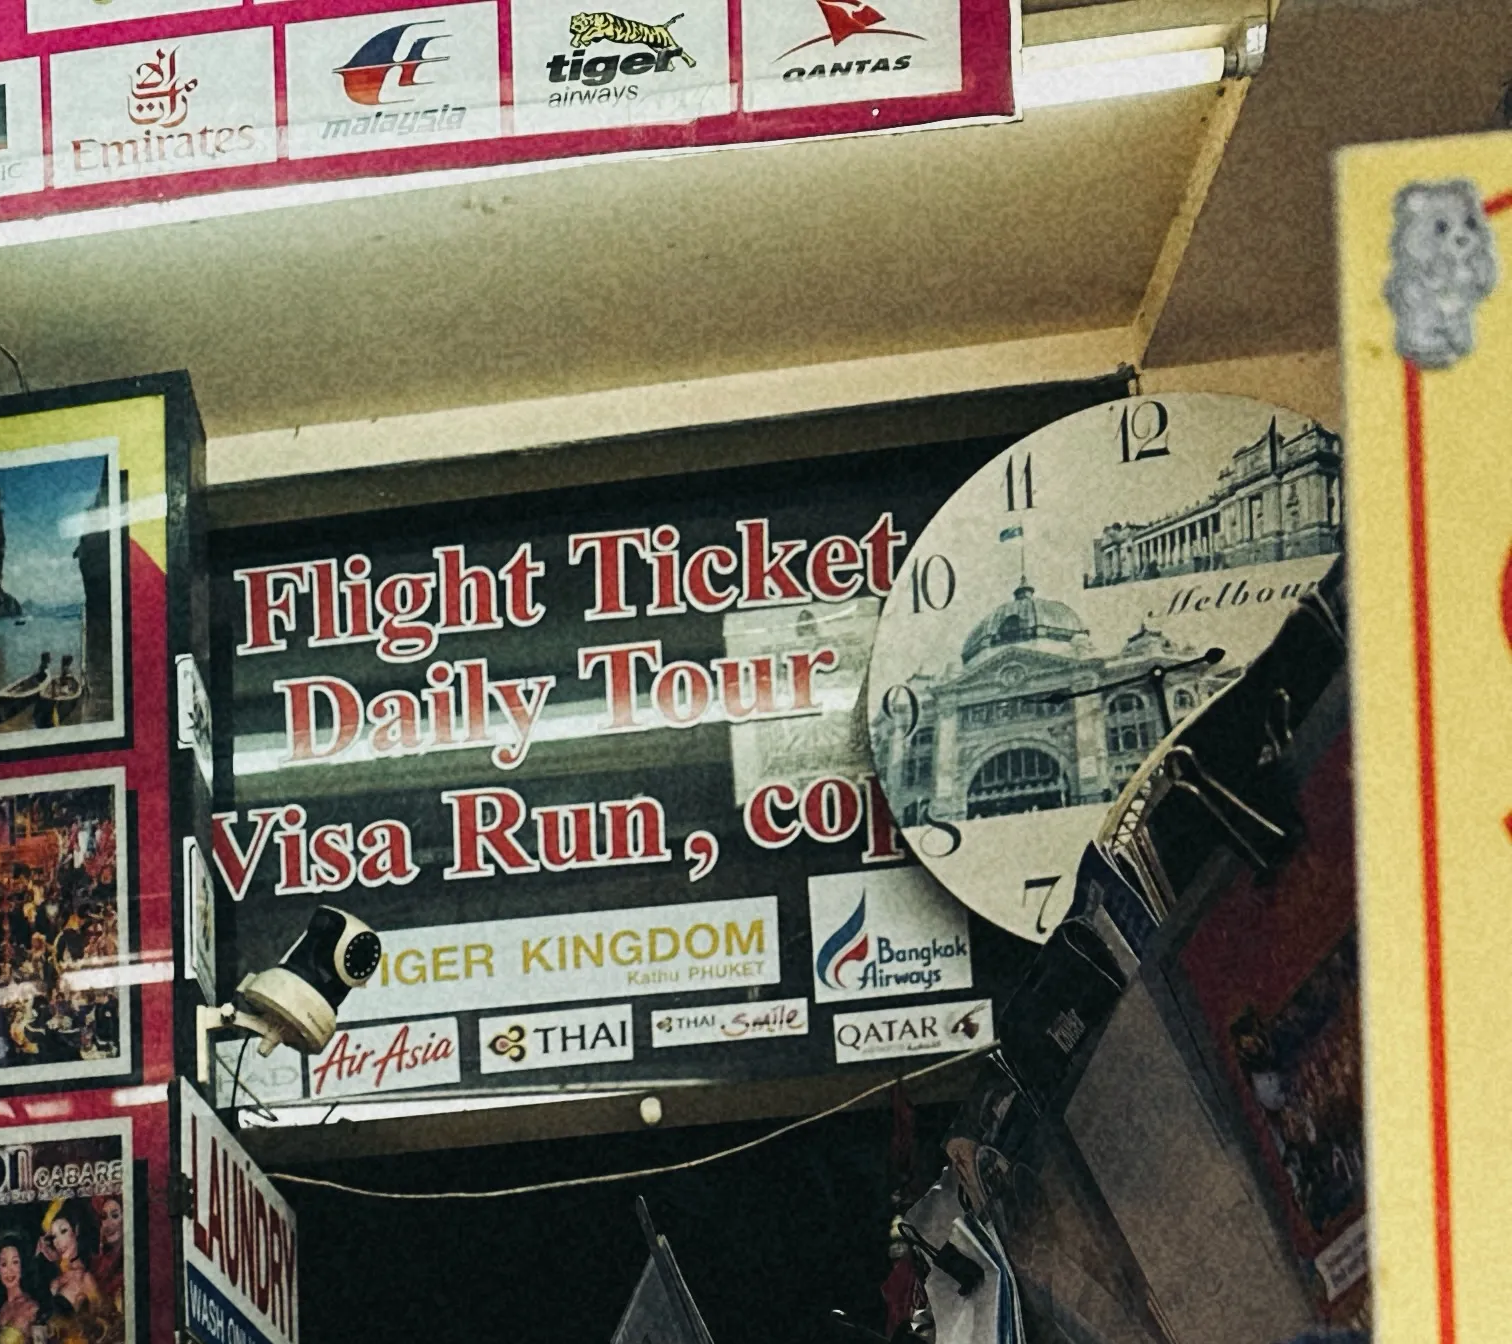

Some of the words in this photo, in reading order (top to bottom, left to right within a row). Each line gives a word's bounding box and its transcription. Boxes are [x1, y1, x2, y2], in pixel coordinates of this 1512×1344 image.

[546, 46, 684, 86] tiger
[782, 54, 913, 83] QANTAS
[321, 104, 467, 140] malaysia
[548, 83, 639, 110] airways
[71, 118, 255, 174] Emirates
[1114, 400, 1171, 463] 12
[1001, 451, 1037, 511] 11
[235, 544, 545, 663] Flight
[570, 511, 907, 621] Ticket
[908, 554, 957, 615] 10
[274, 658, 555, 769] Daily
[578, 640, 836, 733] Tour
[212, 804, 420, 900] Visa
[1023, 875, 1062, 935] 7
[378, 942, 494, 988] IGER
[522, 919, 766, 974] KINGDOM
[627, 966, 680, 986] Kathu
[687, 961, 765, 981] PHUKET
[857, 962, 942, 991] Airways
[876, 936, 968, 966] Bangkok
[533, 1019, 628, 1055] THAI
[675, 1014, 717, 1031] THAI
[836, 1015, 939, 1050] QATAR
[313, 1032, 370, 1094] Air
[372, 1024, 454, 1088] Asia
[191, 1112, 296, 1344] LAUNDRY
[190, 1279, 225, 1343] WASH
